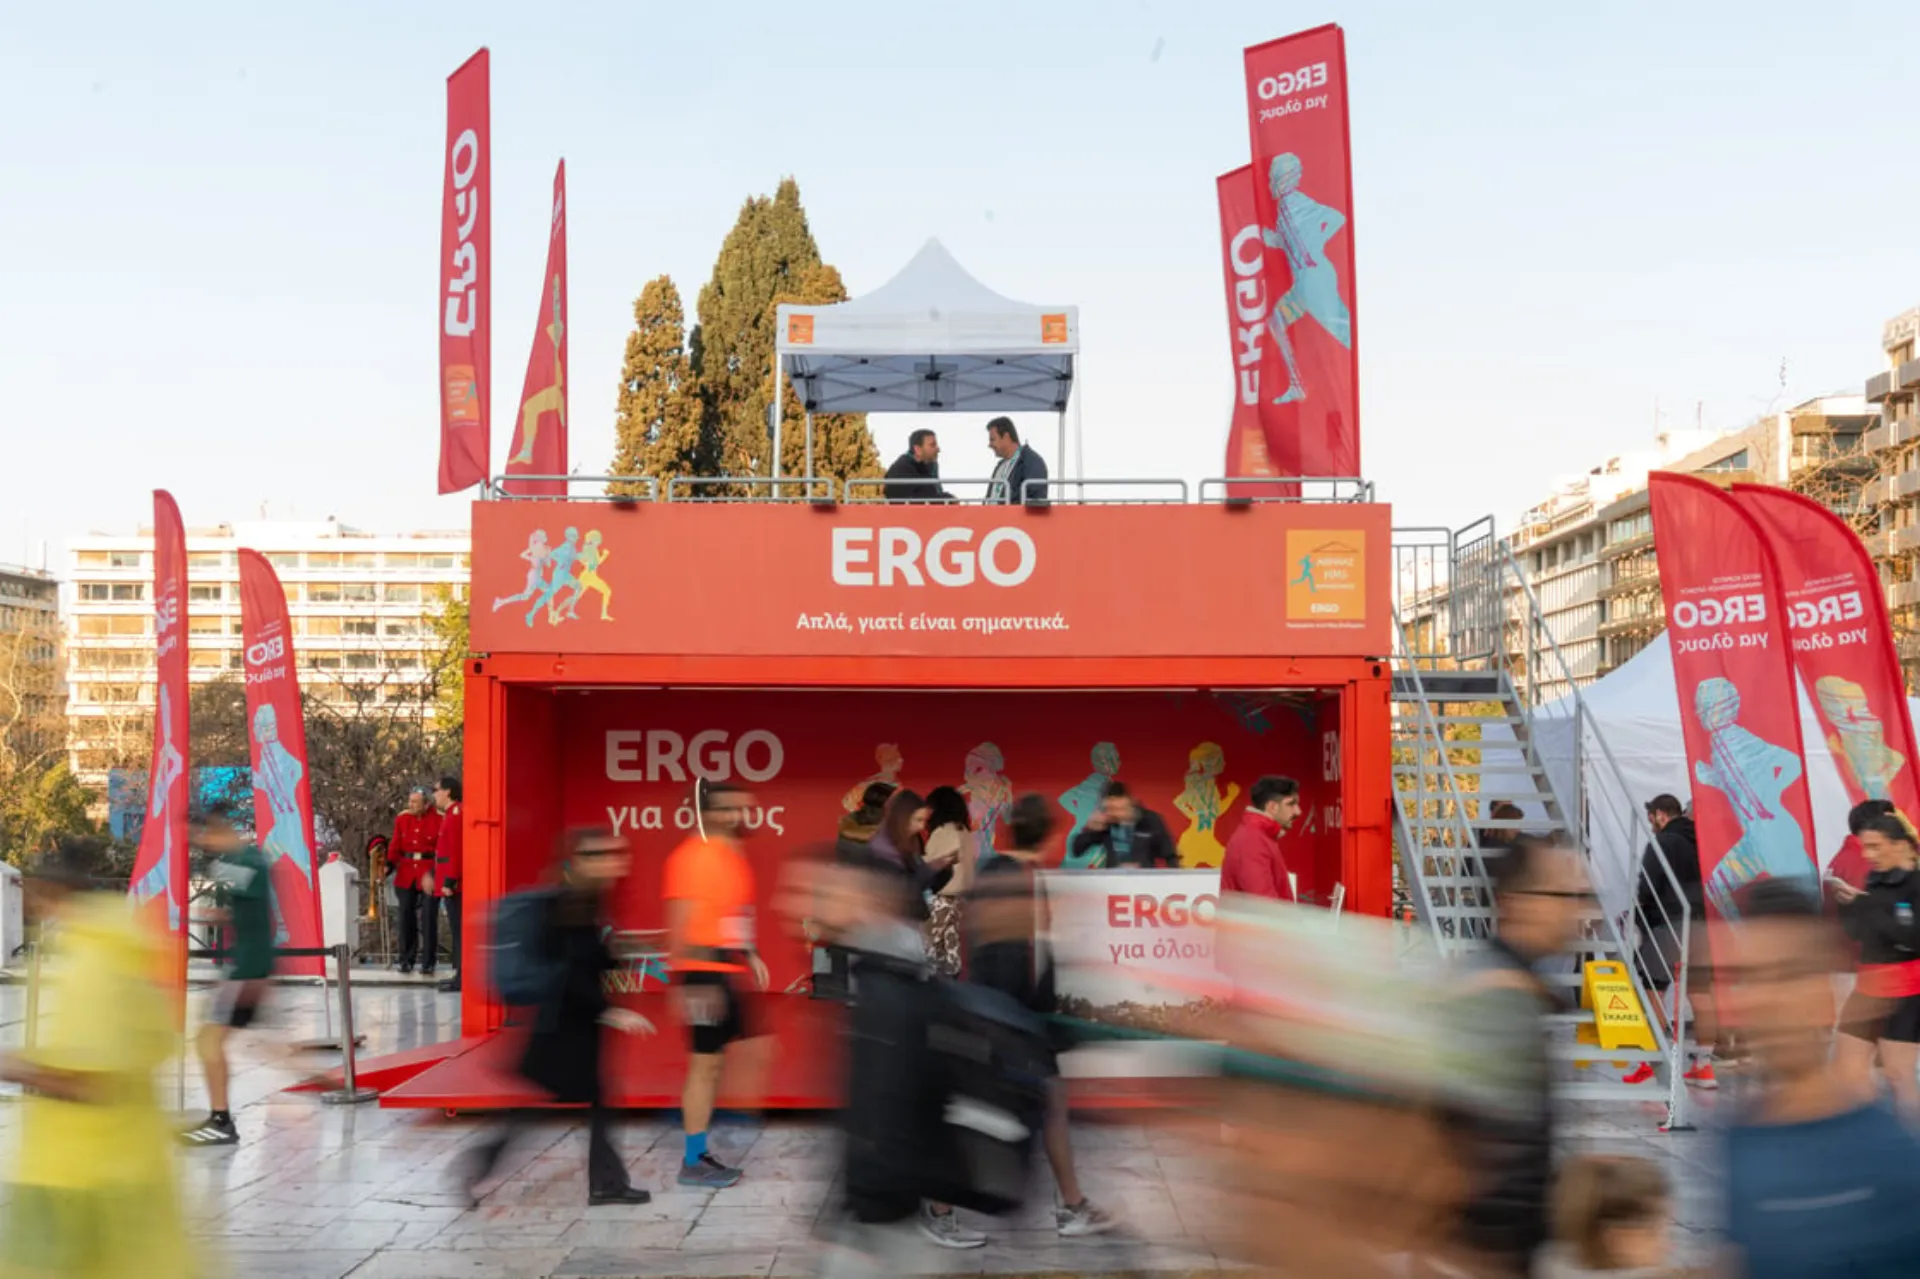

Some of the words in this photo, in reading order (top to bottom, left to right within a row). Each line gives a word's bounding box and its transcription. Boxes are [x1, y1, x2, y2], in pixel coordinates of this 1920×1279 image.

[831, 526, 1037, 587] ERGO
[796, 612, 852, 632] Απλά,
[857, 612, 904, 633] γιατί
[910, 612, 956, 631] είναι
[962, 611, 1070, 634] σημαντικά.
[605, 729, 785, 783] ERGO
[605, 805, 664, 838] για
[673, 797, 785, 836] όυς
[1107, 893, 1220, 928] ERGO
[1108, 943, 1146, 965] για
[1152, 937, 1210, 959] όλου
